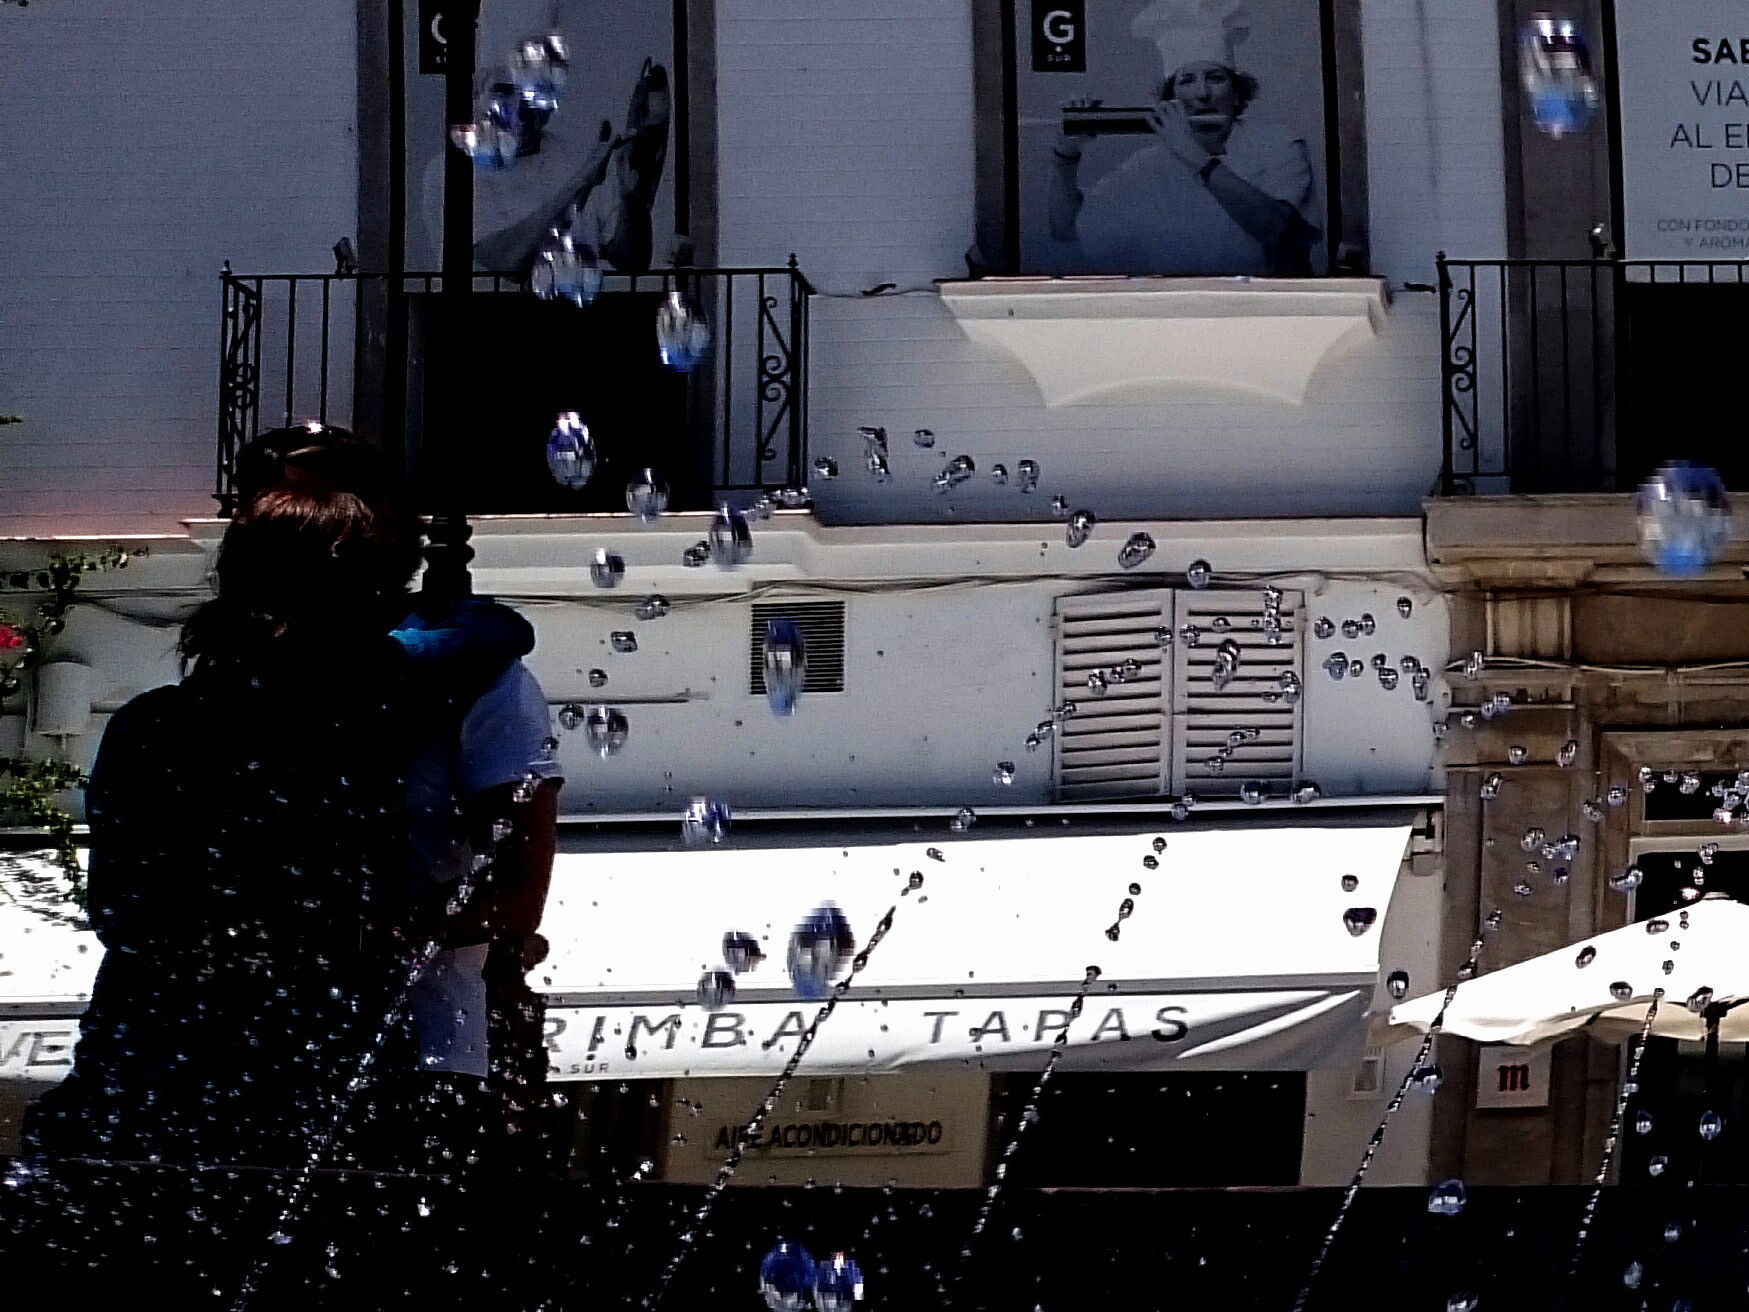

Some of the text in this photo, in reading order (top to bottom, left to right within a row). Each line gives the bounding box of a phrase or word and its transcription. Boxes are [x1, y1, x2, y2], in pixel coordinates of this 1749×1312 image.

[1043, 10, 1074, 44] G
[1670, 123, 1713, 149] AL
[1657, 218, 1691, 233] CON
[923, 1005, 1189, 1045] TAPAS
